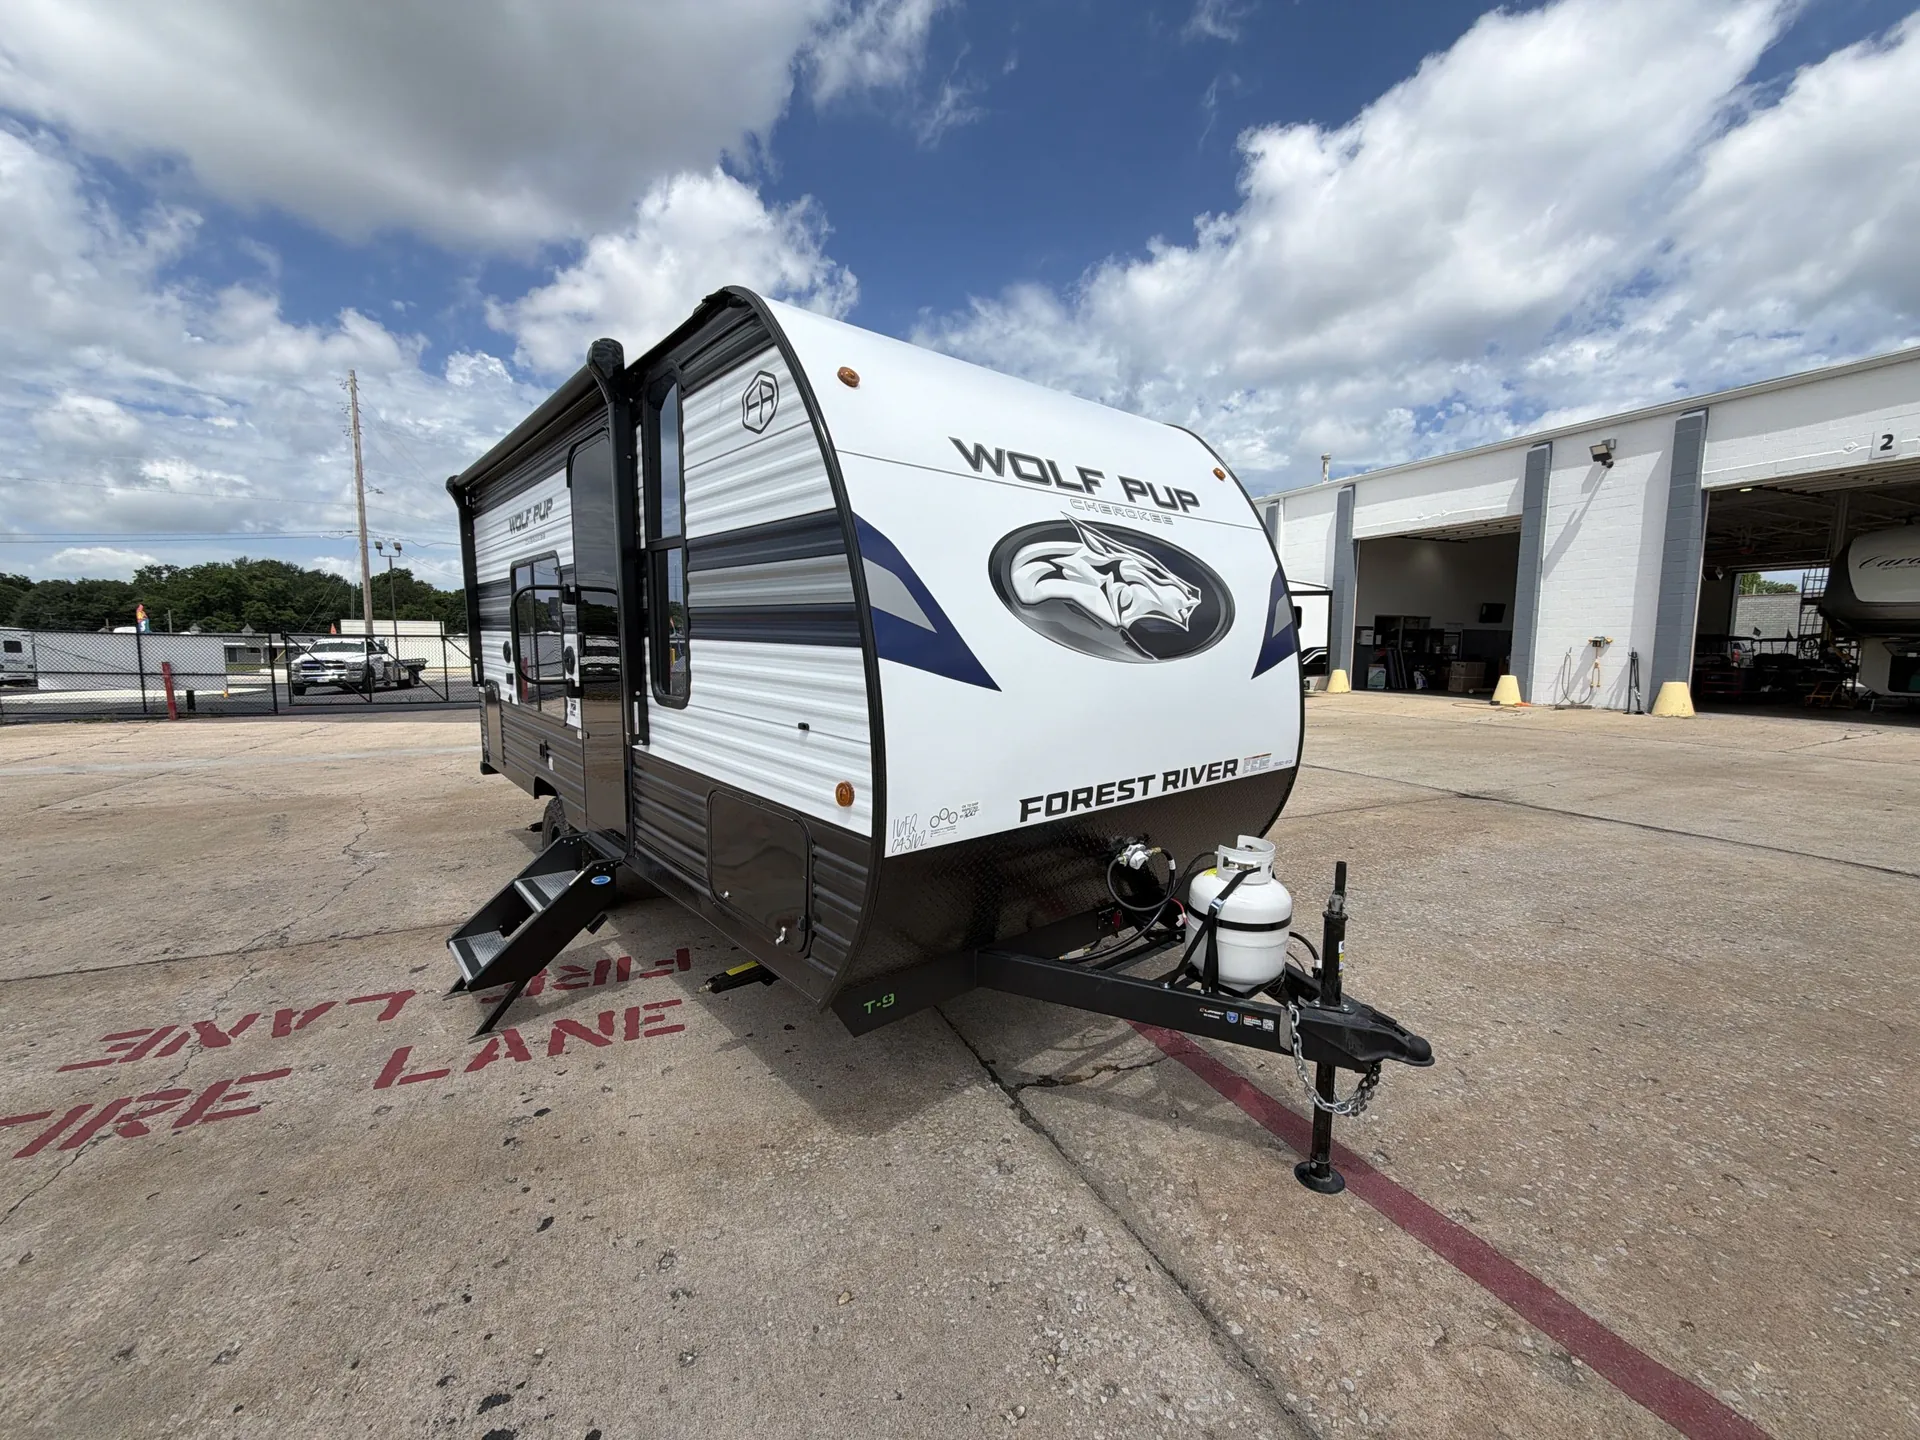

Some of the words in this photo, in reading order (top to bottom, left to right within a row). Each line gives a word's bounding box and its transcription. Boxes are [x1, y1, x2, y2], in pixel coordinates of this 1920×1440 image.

[1880, 433, 1894, 451] 2
[947, 436, 1106, 495] WOLF
[1117, 475, 1201, 514] PUP
[509, 508, 532, 535] WOLF
[533, 498, 553, 524] PUP
[1069, 498, 1174, 526] CHEROKEE
[1019, 774, 1156, 823] FOREST
[1162, 758, 1239, 793] RIVER
[56, 989, 416, 1072] LANE
[0, 1067, 293, 1159] IRE
[373, 998, 686, 1089] LANE
